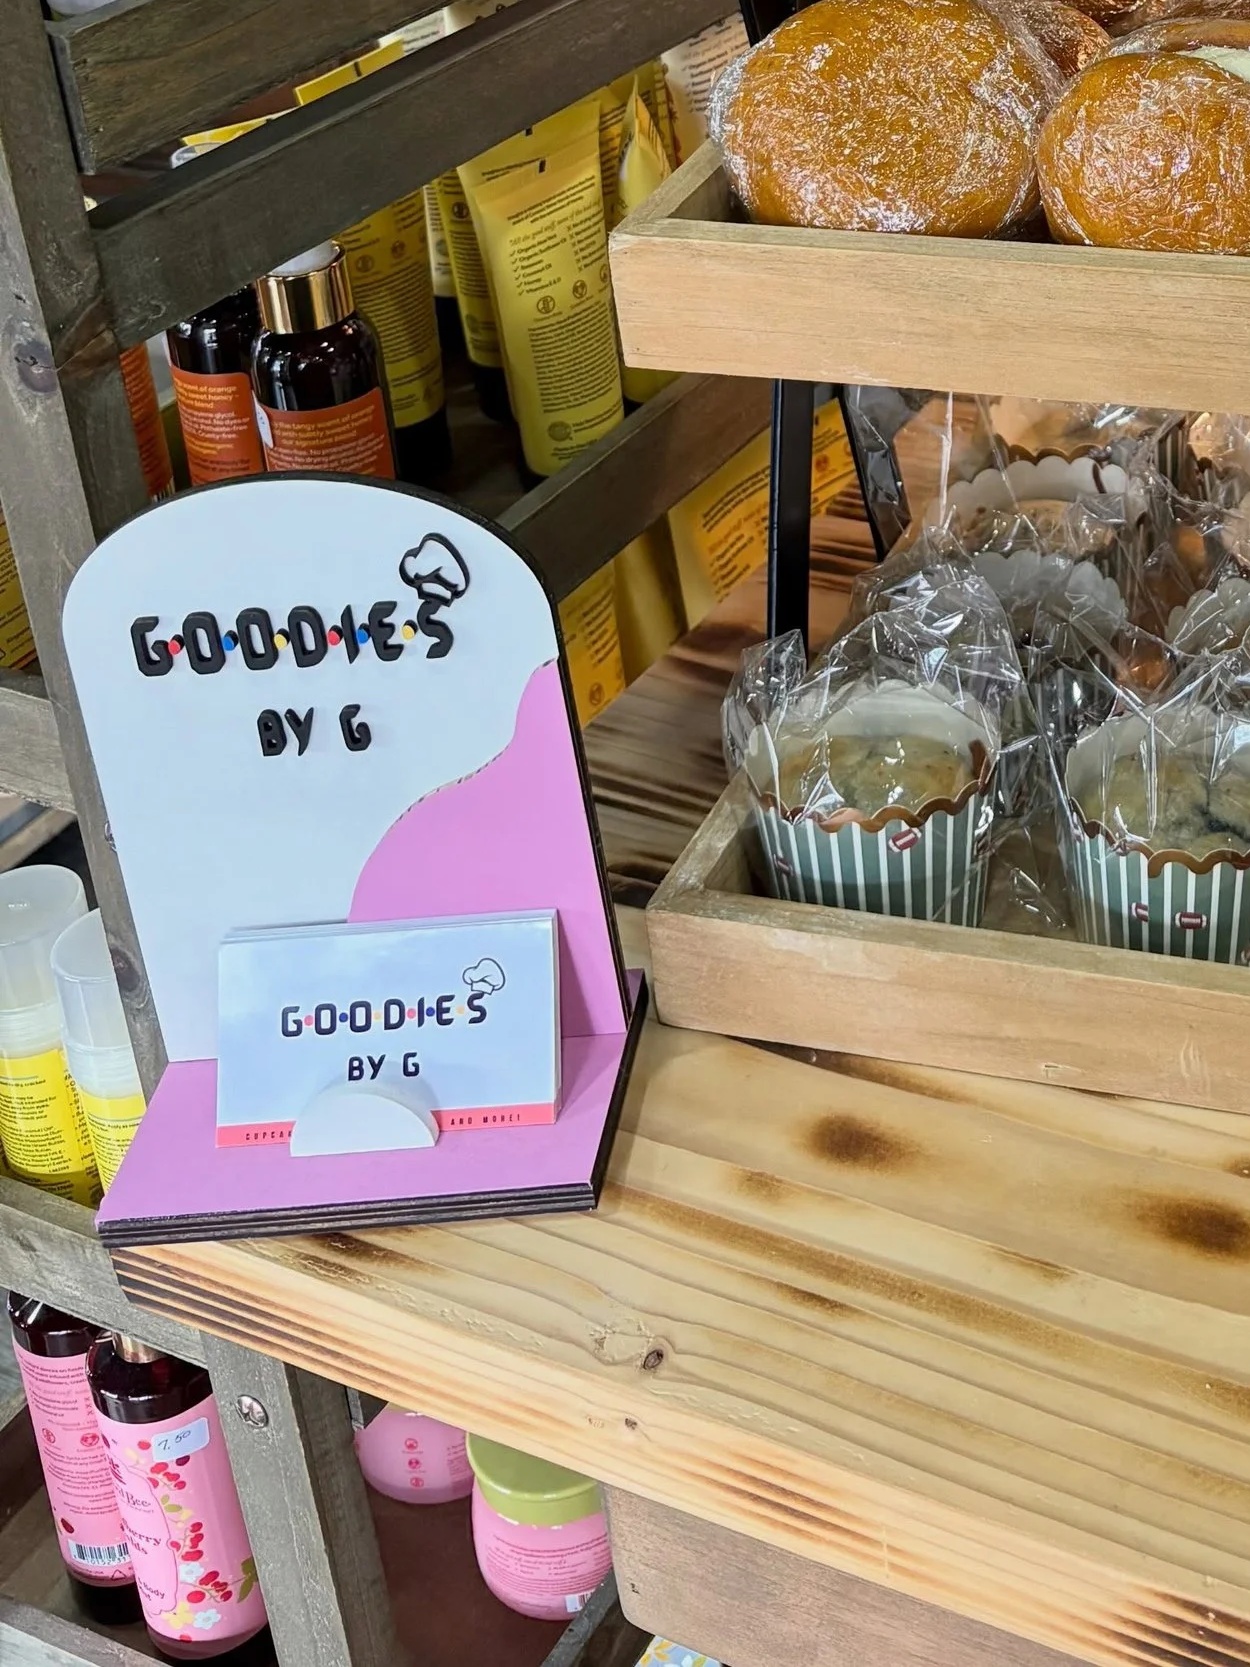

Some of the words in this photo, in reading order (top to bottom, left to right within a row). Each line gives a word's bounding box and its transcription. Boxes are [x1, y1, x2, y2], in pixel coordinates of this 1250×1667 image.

[257, 706, 314, 757] BY
[339, 703, 372, 752] G
[347, 1053, 386, 1081] BY
[402, 1052, 420, 1077] G
[450, 1116, 473, 1126] AND
[483, 1113, 521, 1124] MORE!
